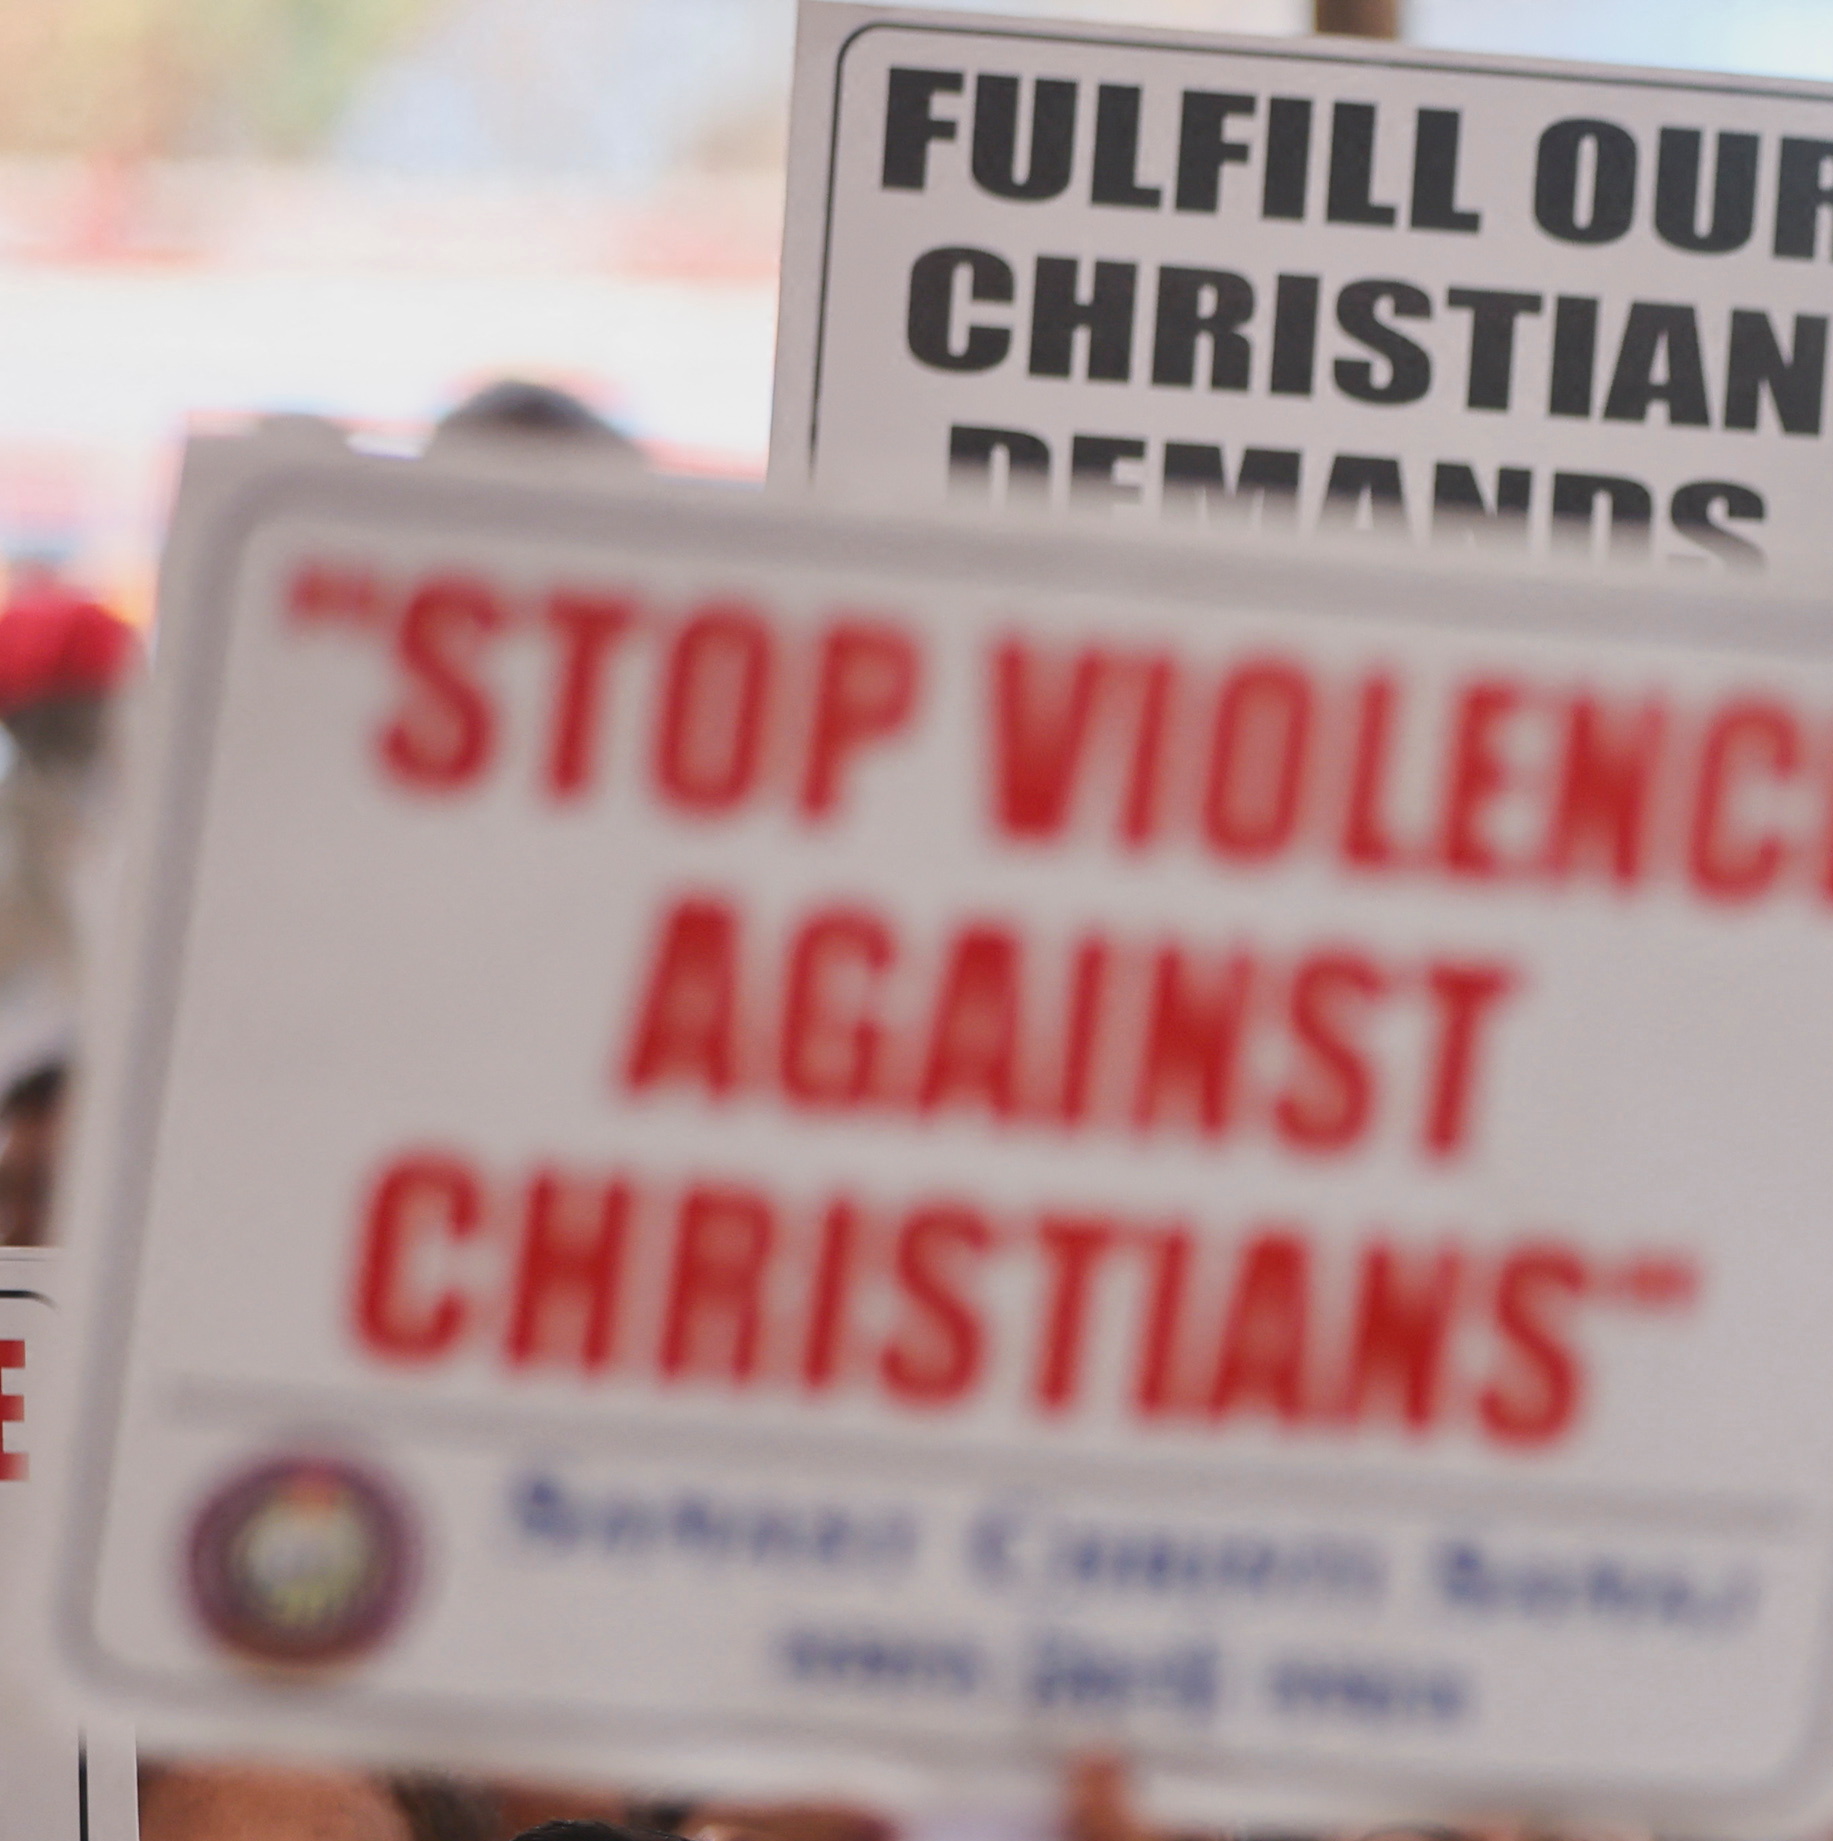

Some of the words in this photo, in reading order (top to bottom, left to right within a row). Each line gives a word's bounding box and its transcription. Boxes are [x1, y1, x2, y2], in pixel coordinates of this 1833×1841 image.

[881, 66, 1480, 234] FULFILL
[906, 246, 1829, 437] CHRISTIAN
[610, 883, 1526, 1169] AGAINST
[342, 1144, 1702, 1451] CHRISTIANS"
